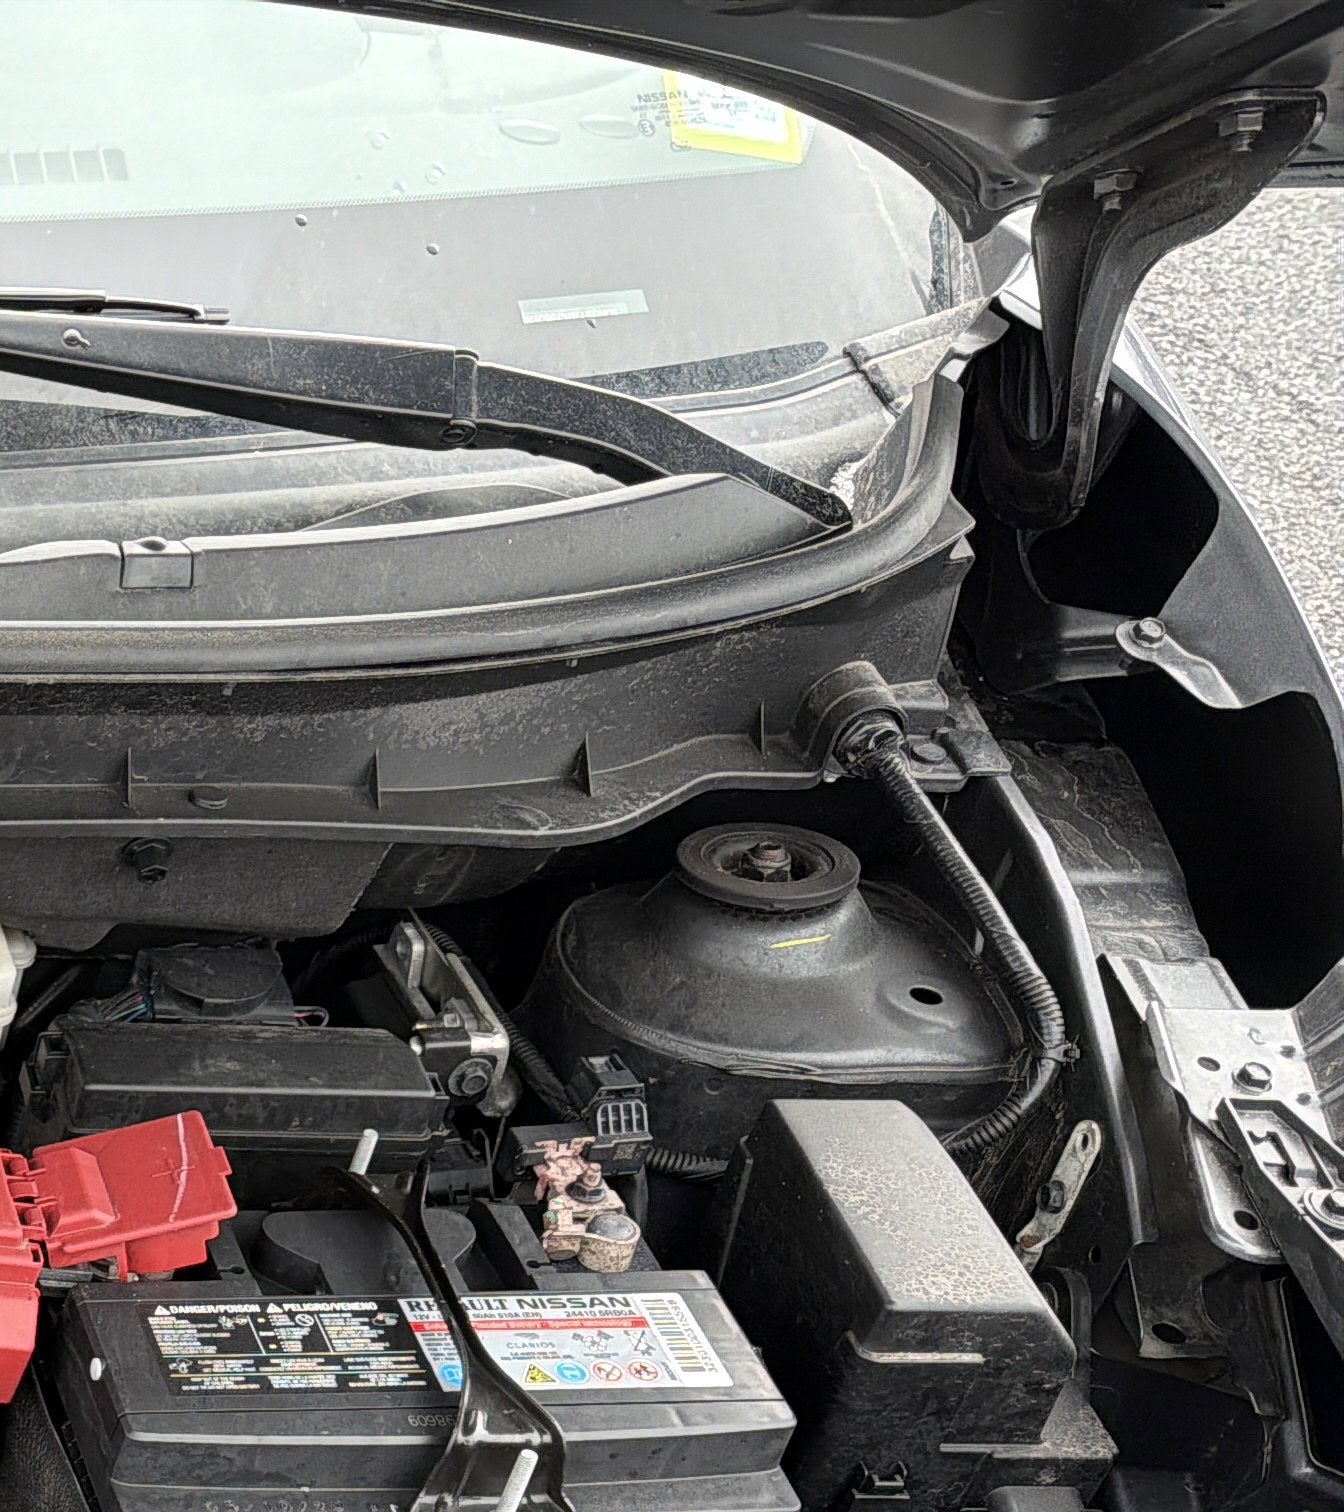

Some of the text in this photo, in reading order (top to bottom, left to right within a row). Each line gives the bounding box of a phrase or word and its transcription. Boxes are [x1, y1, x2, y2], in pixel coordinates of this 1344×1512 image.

[282, 1302, 378, 1312] PELIGRO/VENENO
[515, 1296, 632, 1310] NISSAN
[169, 1304, 261, 1314] DANGER/POISON
[506, 1341, 557, 1350] CLARIOS
